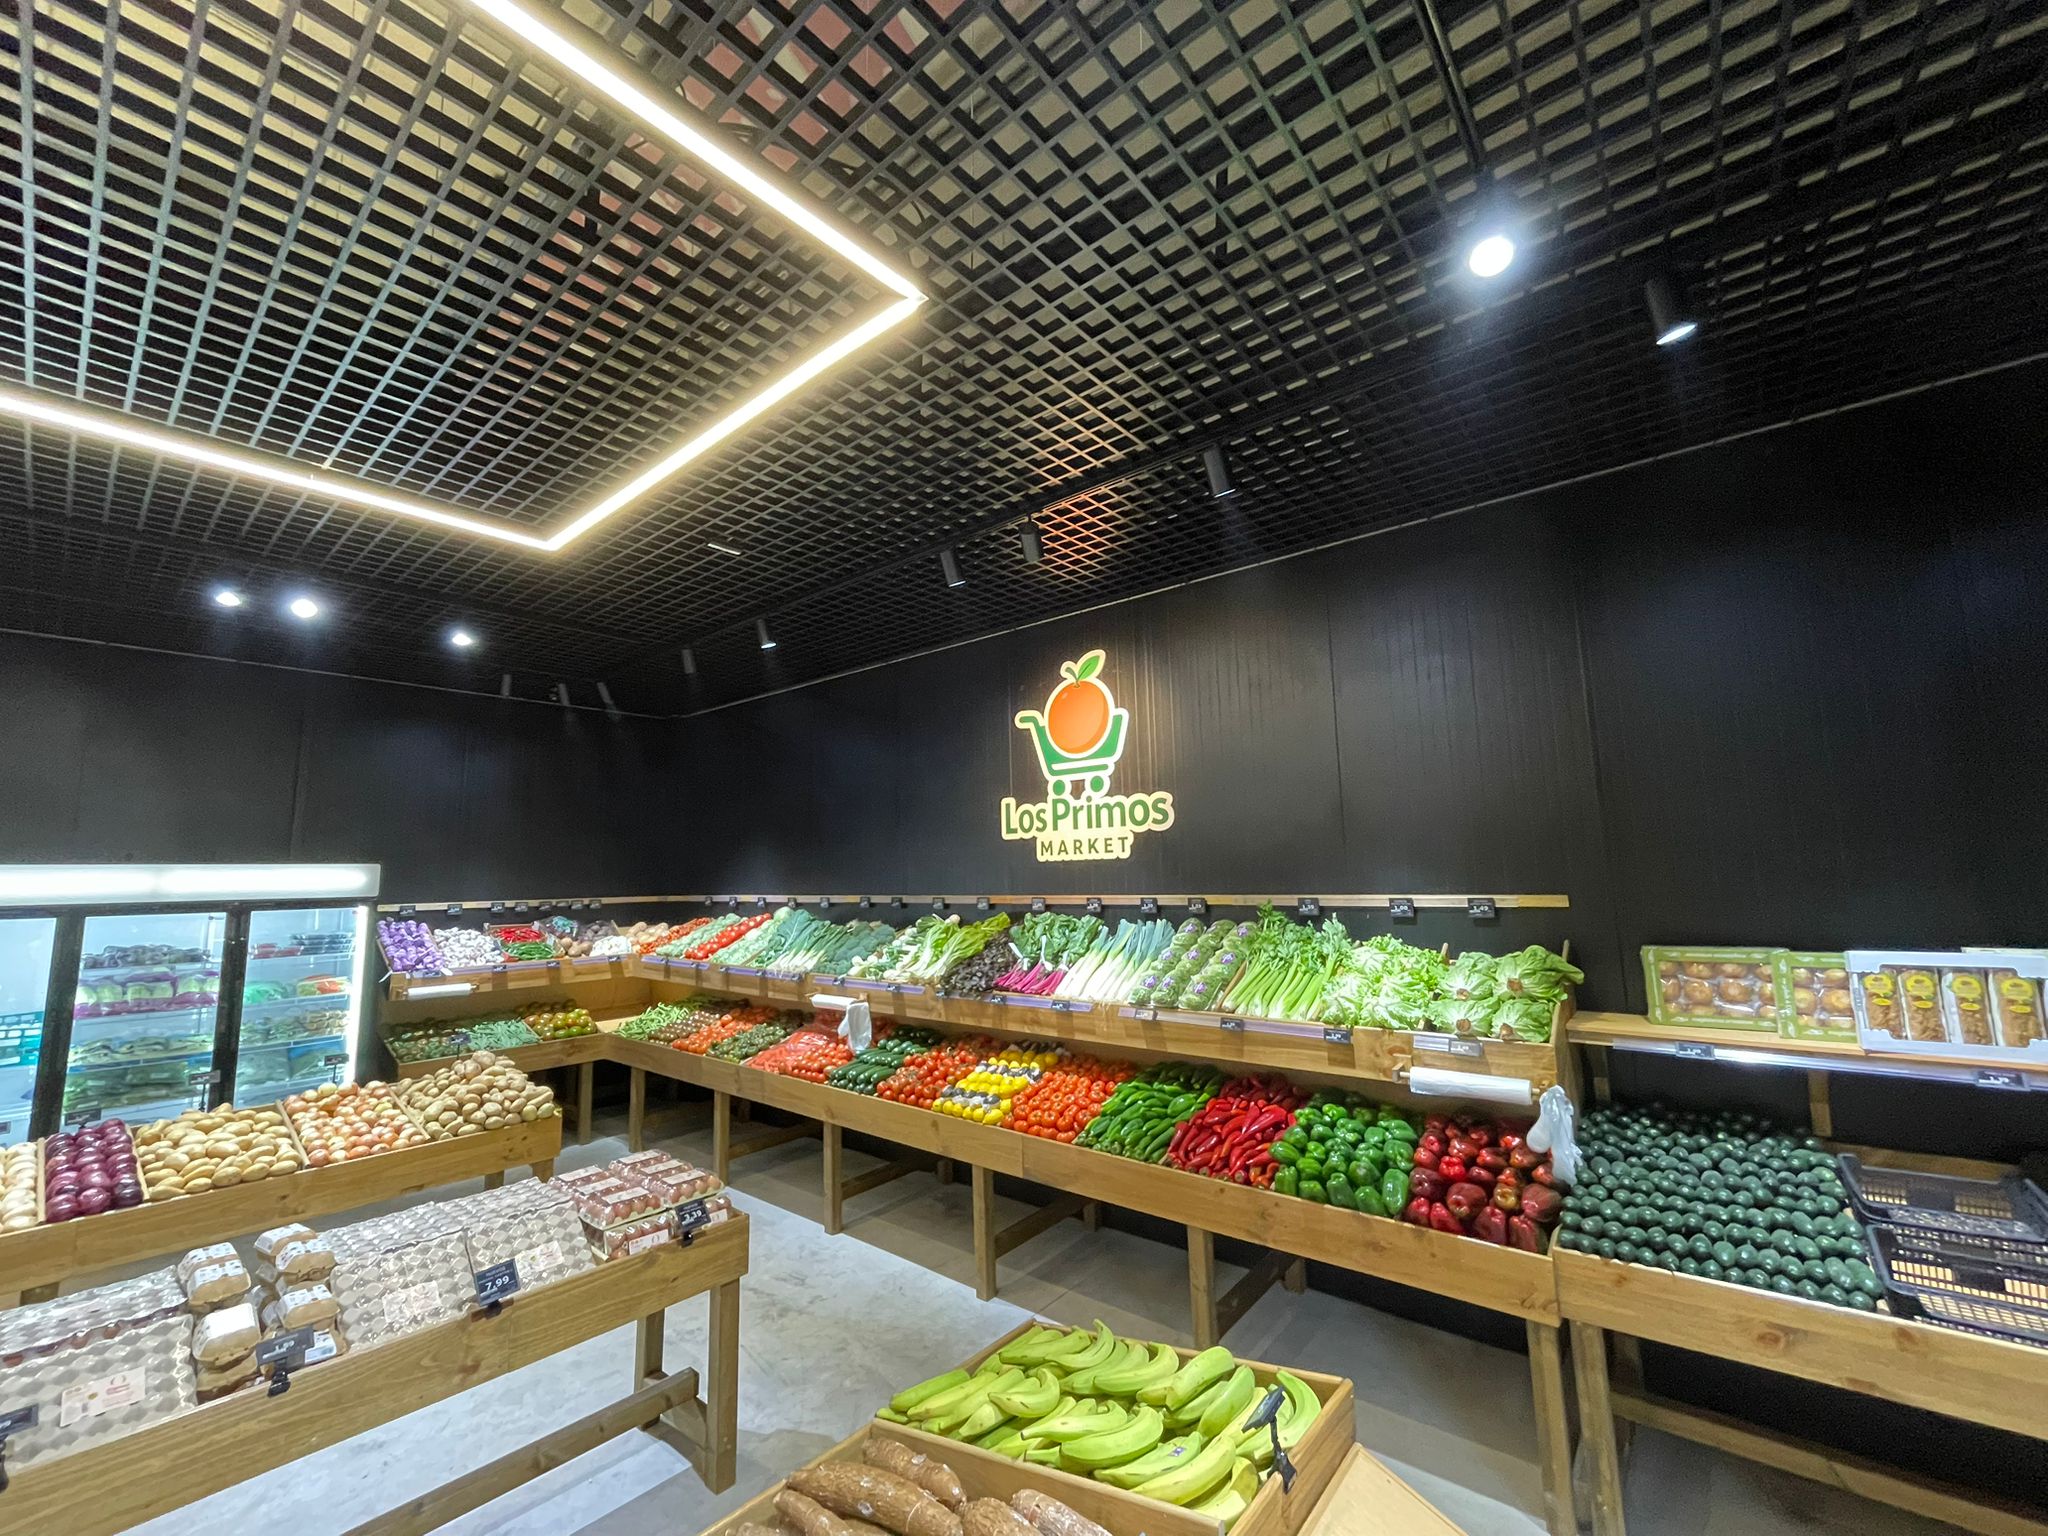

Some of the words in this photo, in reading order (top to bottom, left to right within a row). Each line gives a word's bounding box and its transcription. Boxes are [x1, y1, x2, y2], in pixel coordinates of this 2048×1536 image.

[1005, 803, 1048, 834] Los
[1052, 795, 1170, 832] Primos
[1040, 836, 1129, 856] MARKET
[485, 1275, 510, 1292] 7.99
